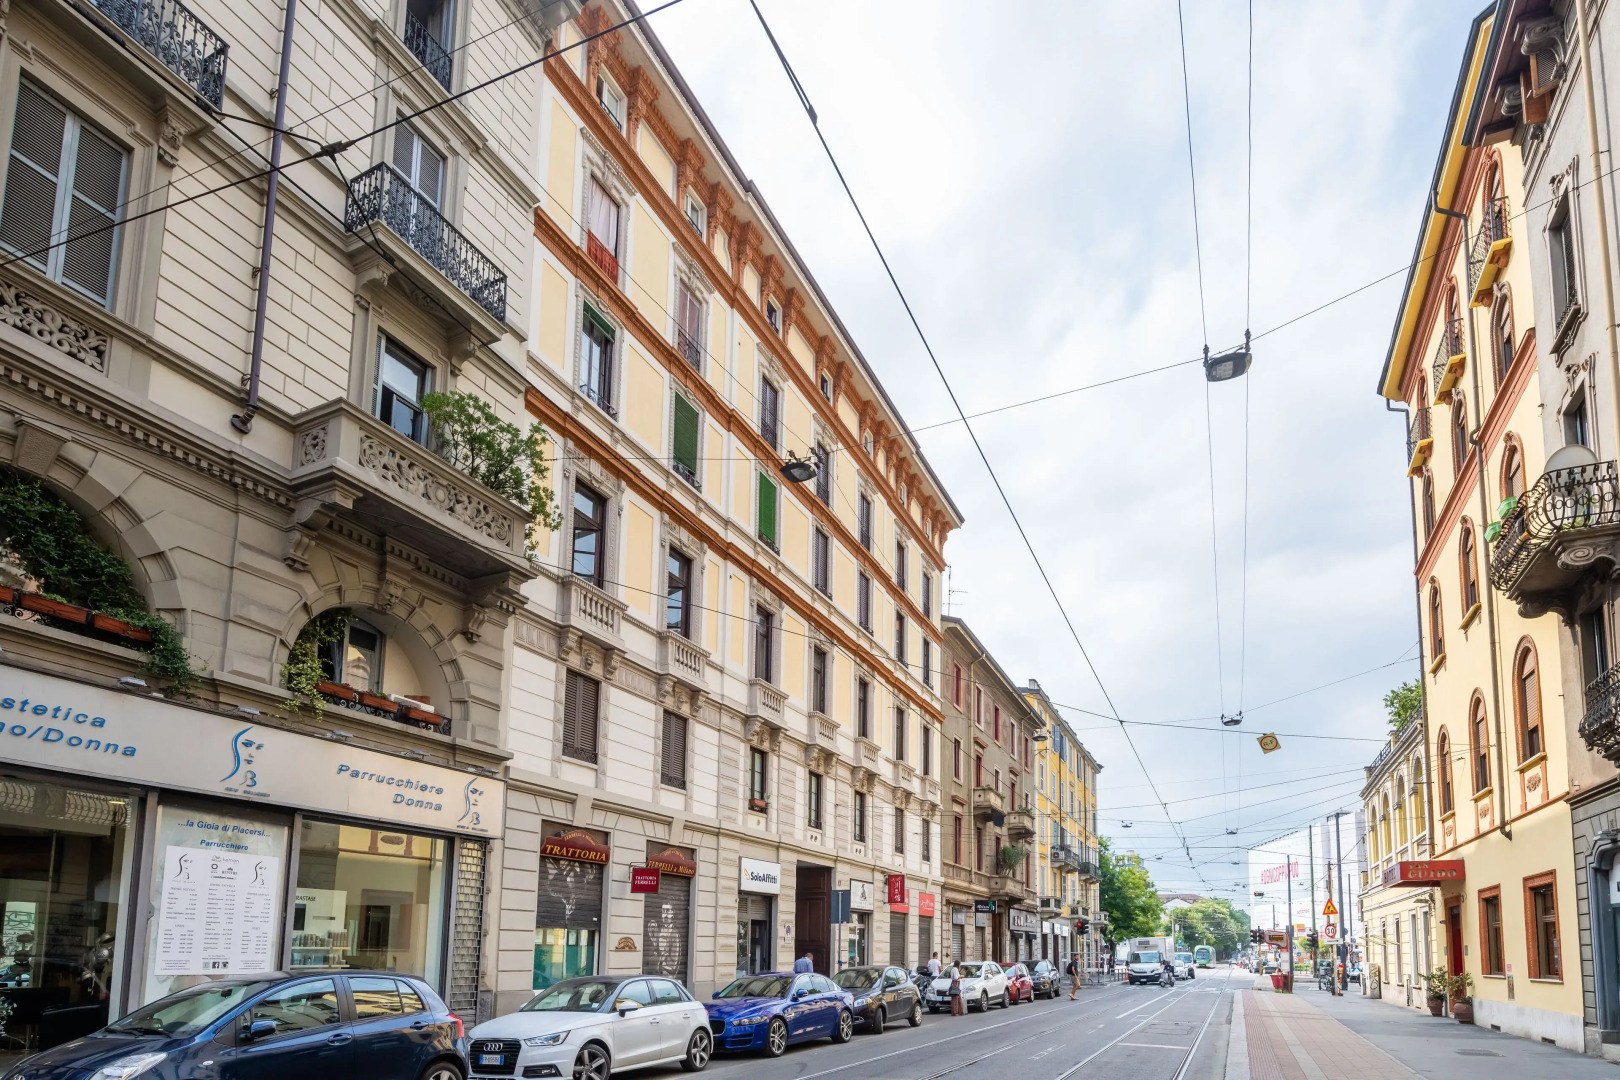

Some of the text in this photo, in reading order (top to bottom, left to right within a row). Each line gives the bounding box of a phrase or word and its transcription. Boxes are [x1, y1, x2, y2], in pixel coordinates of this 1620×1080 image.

[0, 697, 106, 728] stetica
[337, 764, 444, 795] Parrucchiere
[393, 793, 443, 812] Donna
[197, 821, 219, 831] Gioia
[221, 824, 230, 832] di
[200, 839, 249, 851] Parrucchiere
[546, 844, 606, 861] TRATTORIA
[750, 871, 778, 885] SoloAffitti
[1408, 868, 1457, 879] GUIDO
